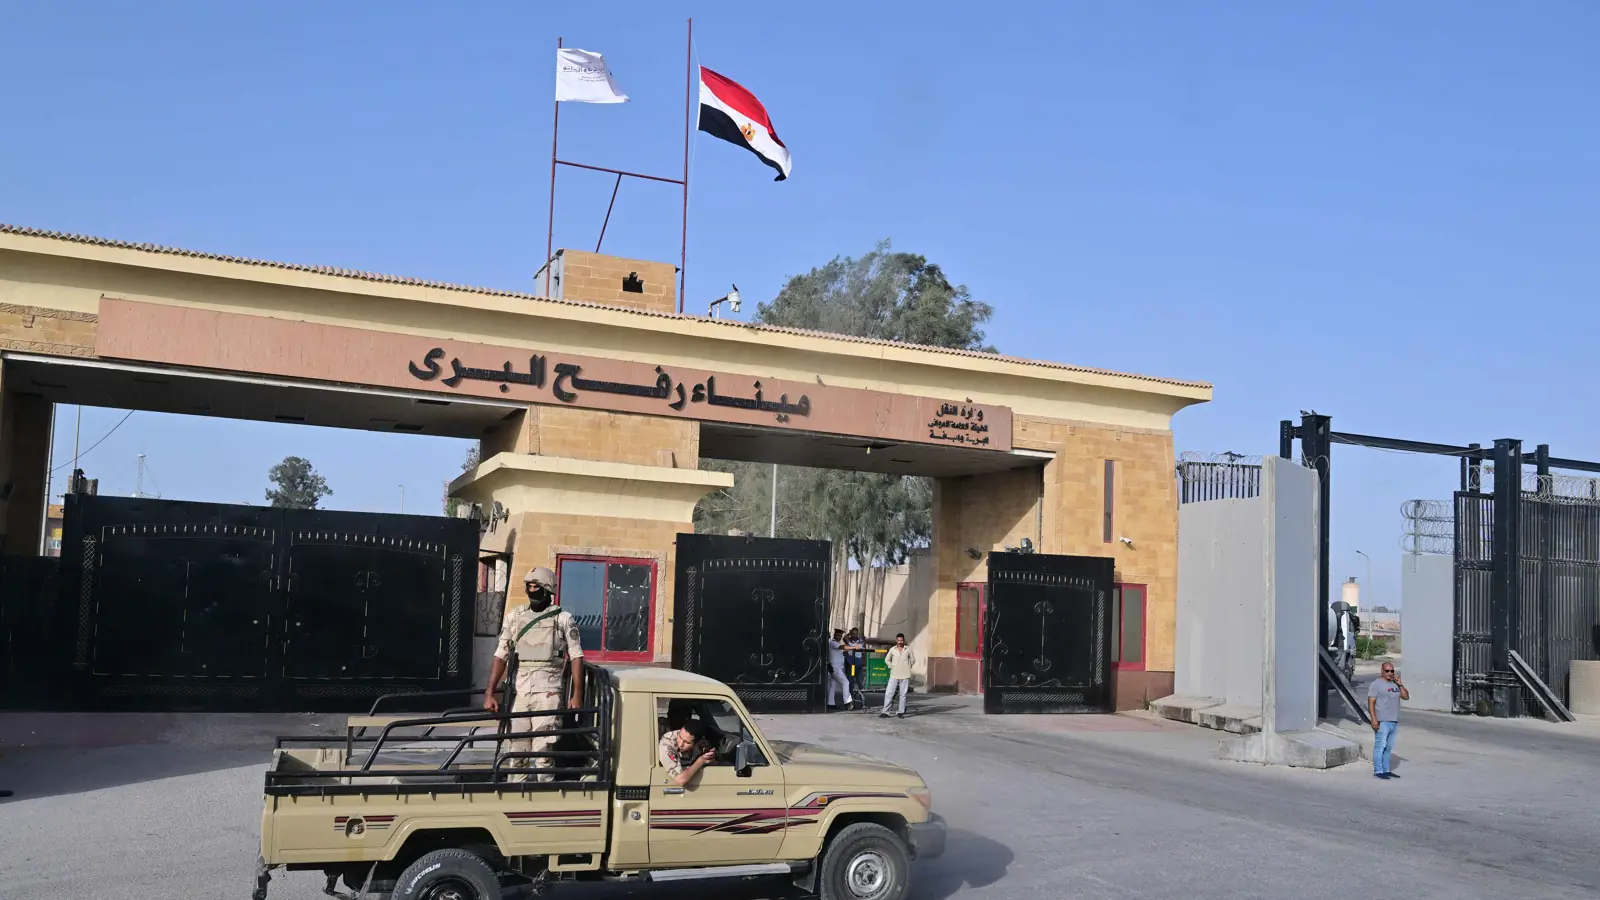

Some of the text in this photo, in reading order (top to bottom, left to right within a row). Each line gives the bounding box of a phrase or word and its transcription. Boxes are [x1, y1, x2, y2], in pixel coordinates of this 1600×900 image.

[552, 362, 686, 411] رفح
[691, 375, 811, 422] ميناء
[936, 403, 958, 417] النقل
[410, 863, 441, 887] MICHELIN
